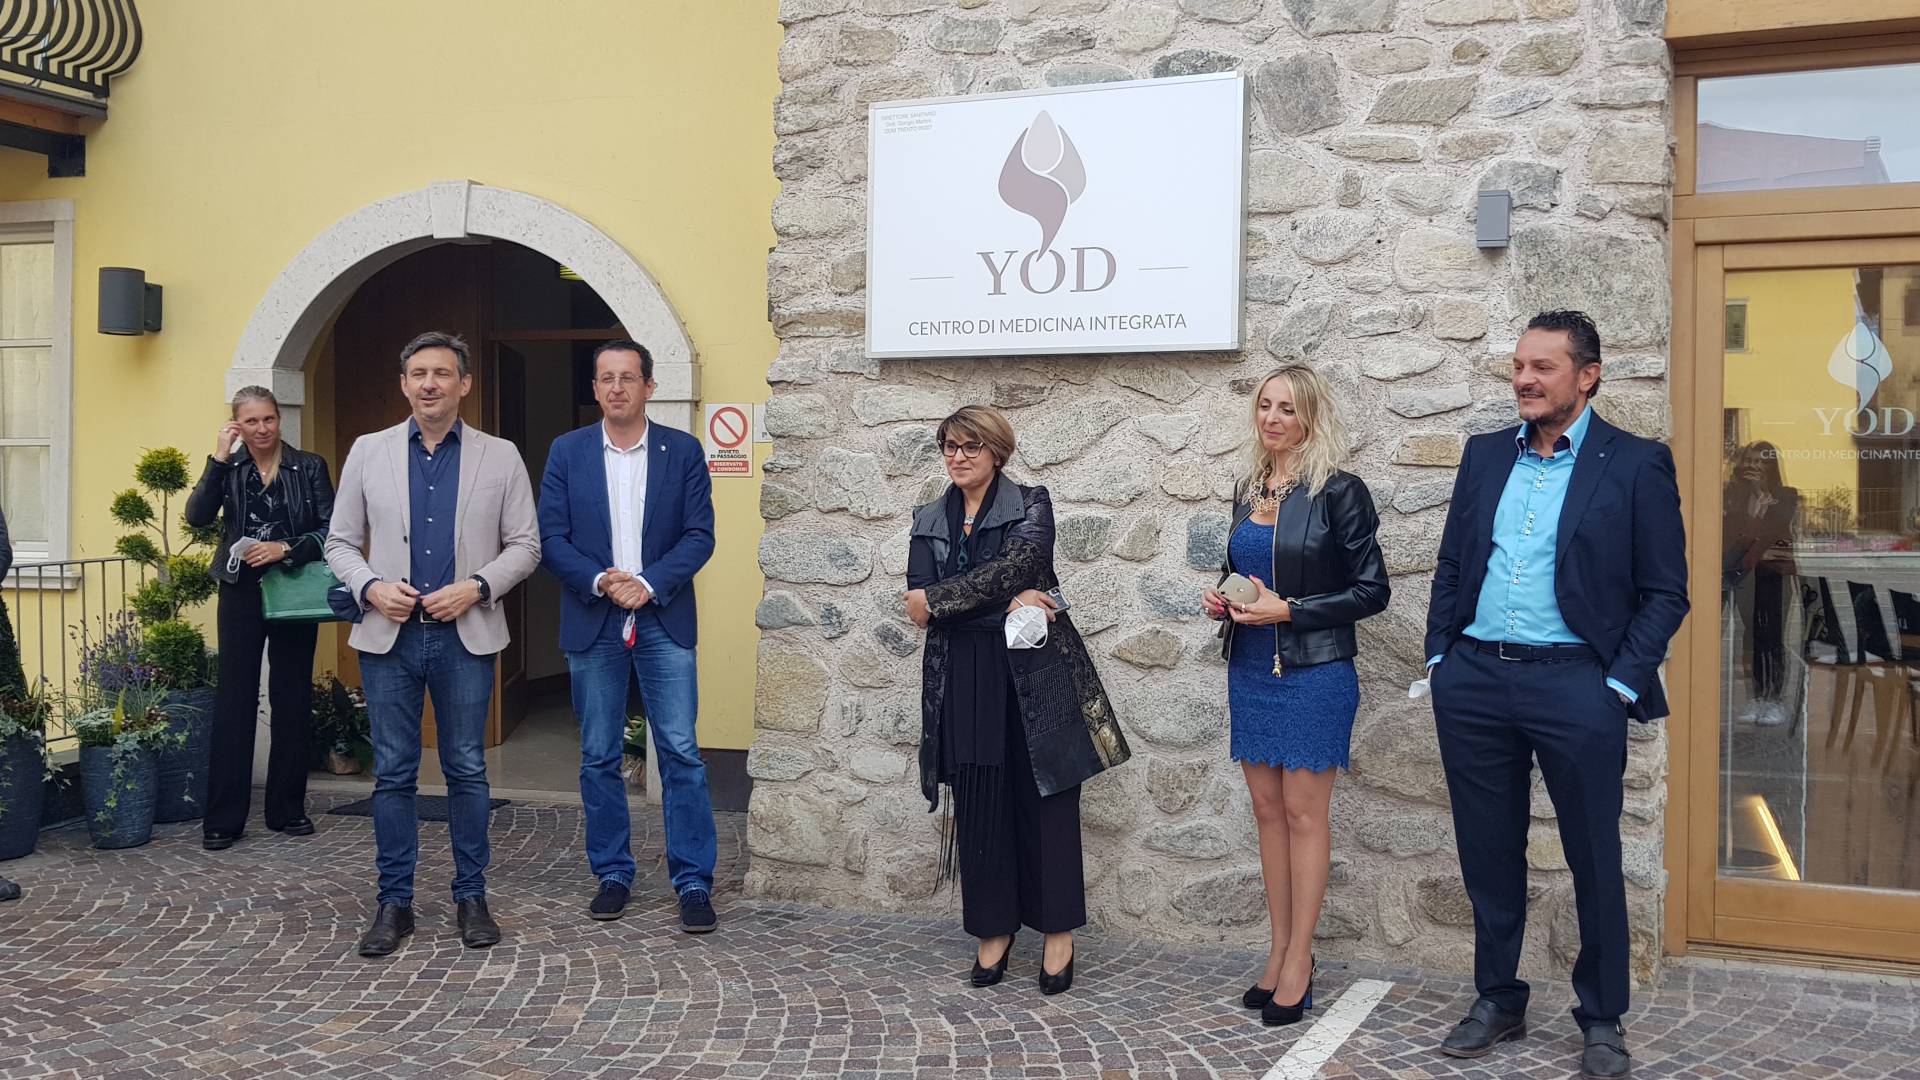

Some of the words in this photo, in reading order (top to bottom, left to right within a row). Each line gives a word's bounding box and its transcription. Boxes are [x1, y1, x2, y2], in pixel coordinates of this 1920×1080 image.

[977, 246, 1117, 296] YOD
[909, 320, 975, 336] CENTRO
[978, 319, 995, 334] DI
[999, 316, 1085, 334] MEDICINA
[1089, 313, 1187, 331] INTEGRATA
[1813, 407, 1916, 437] YOD
[1760, 449, 1810, 460] CENTRO
[1813, 449, 1825, 460] DI
[1829, 449, 1892, 460] MEDICINA
